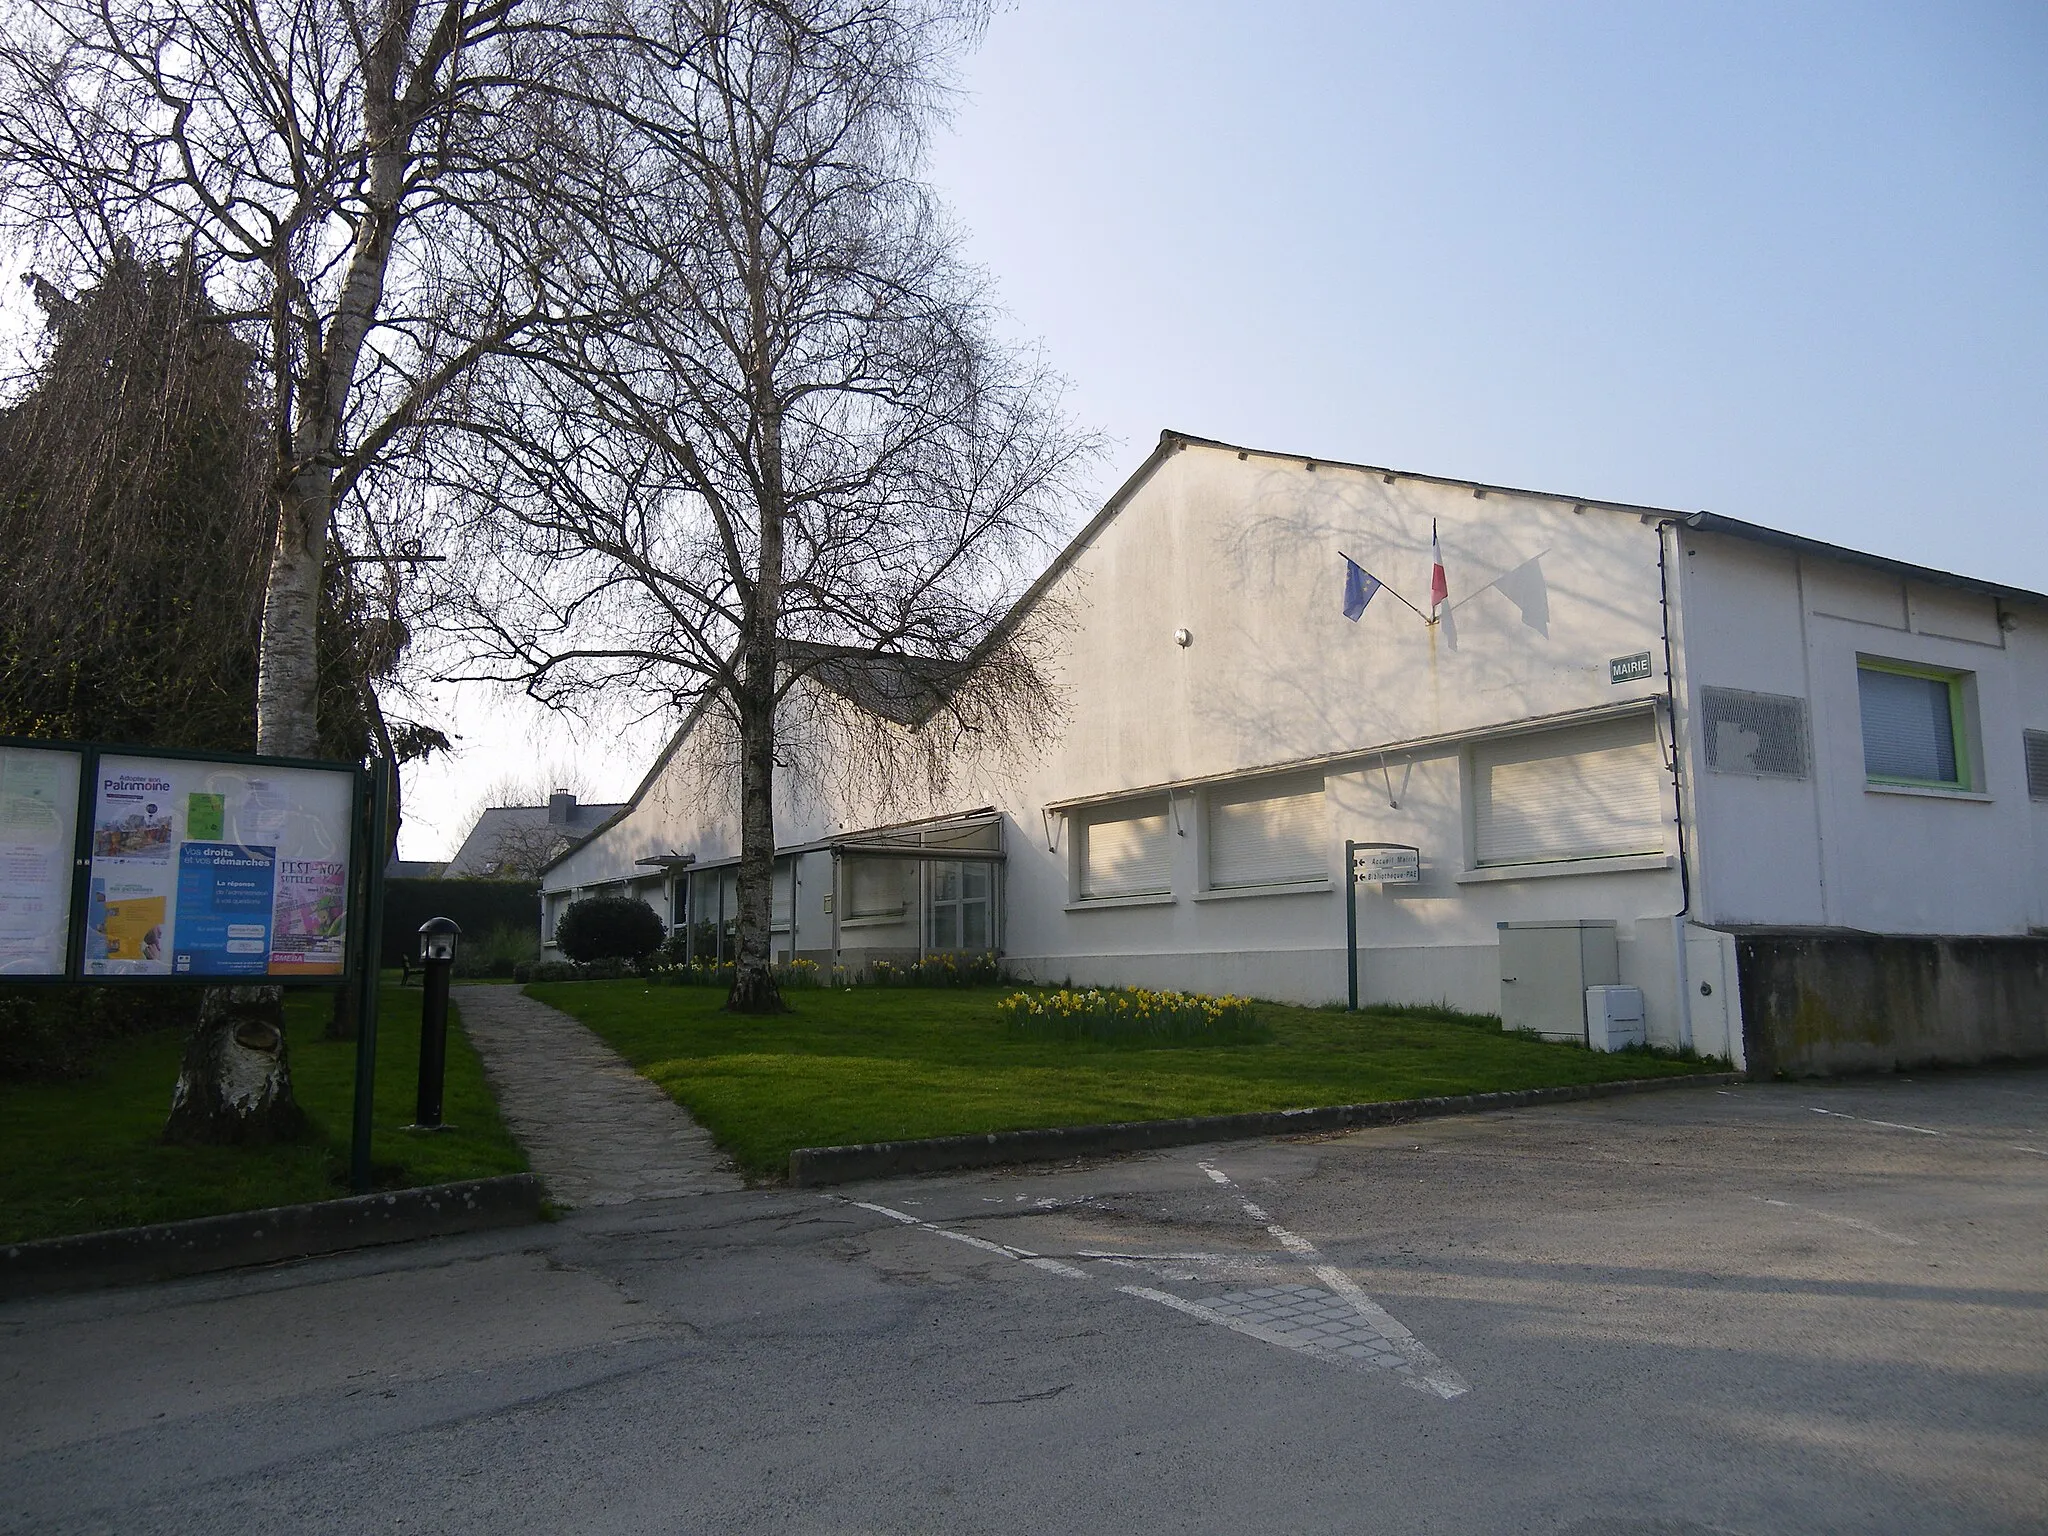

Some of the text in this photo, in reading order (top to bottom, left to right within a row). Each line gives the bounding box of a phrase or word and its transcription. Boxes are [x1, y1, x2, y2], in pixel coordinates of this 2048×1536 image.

[1613, 660, 1648, 676] MAIRIE
[104, 780, 170, 791] Patrimoine
[184, 848, 234, 856] Vos droits
[213, 857, 270, 867] démarches
[1372, 857, 1394, 865] Accueil
